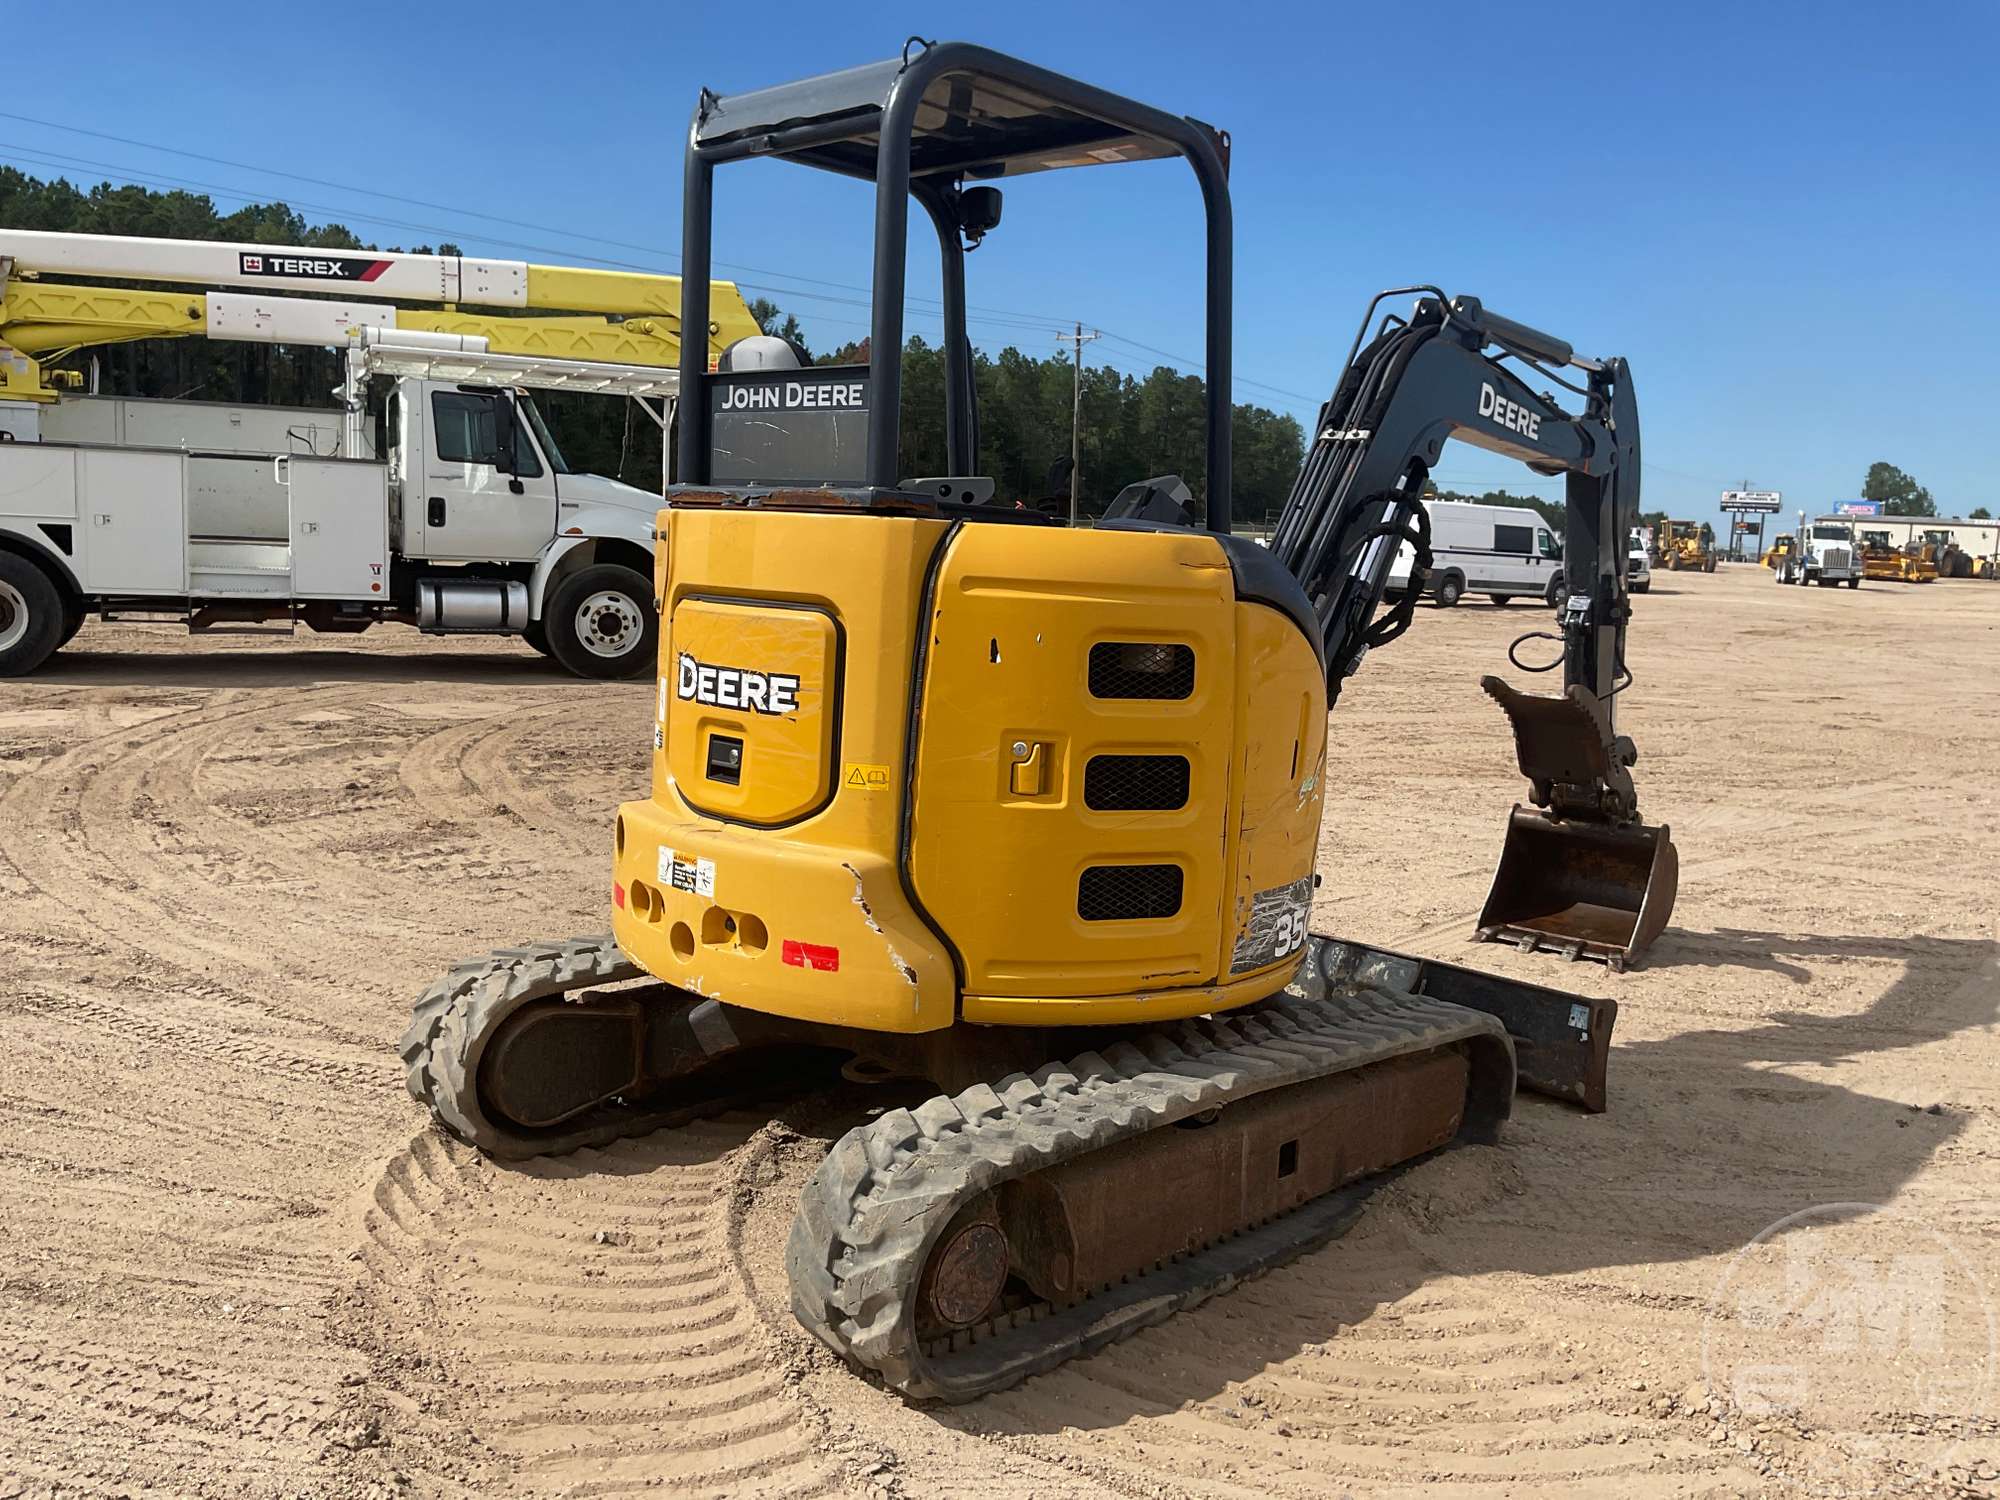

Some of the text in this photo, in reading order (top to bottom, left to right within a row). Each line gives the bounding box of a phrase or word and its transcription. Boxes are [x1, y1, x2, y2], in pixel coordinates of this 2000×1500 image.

[269, 258, 343, 276] TEREX
[722, 382, 864, 409] JOHN DEERE
[1478, 382, 1541, 440] DEERE
[678, 653, 800, 715] DEERE
[1274, 905, 1311, 957] 35
